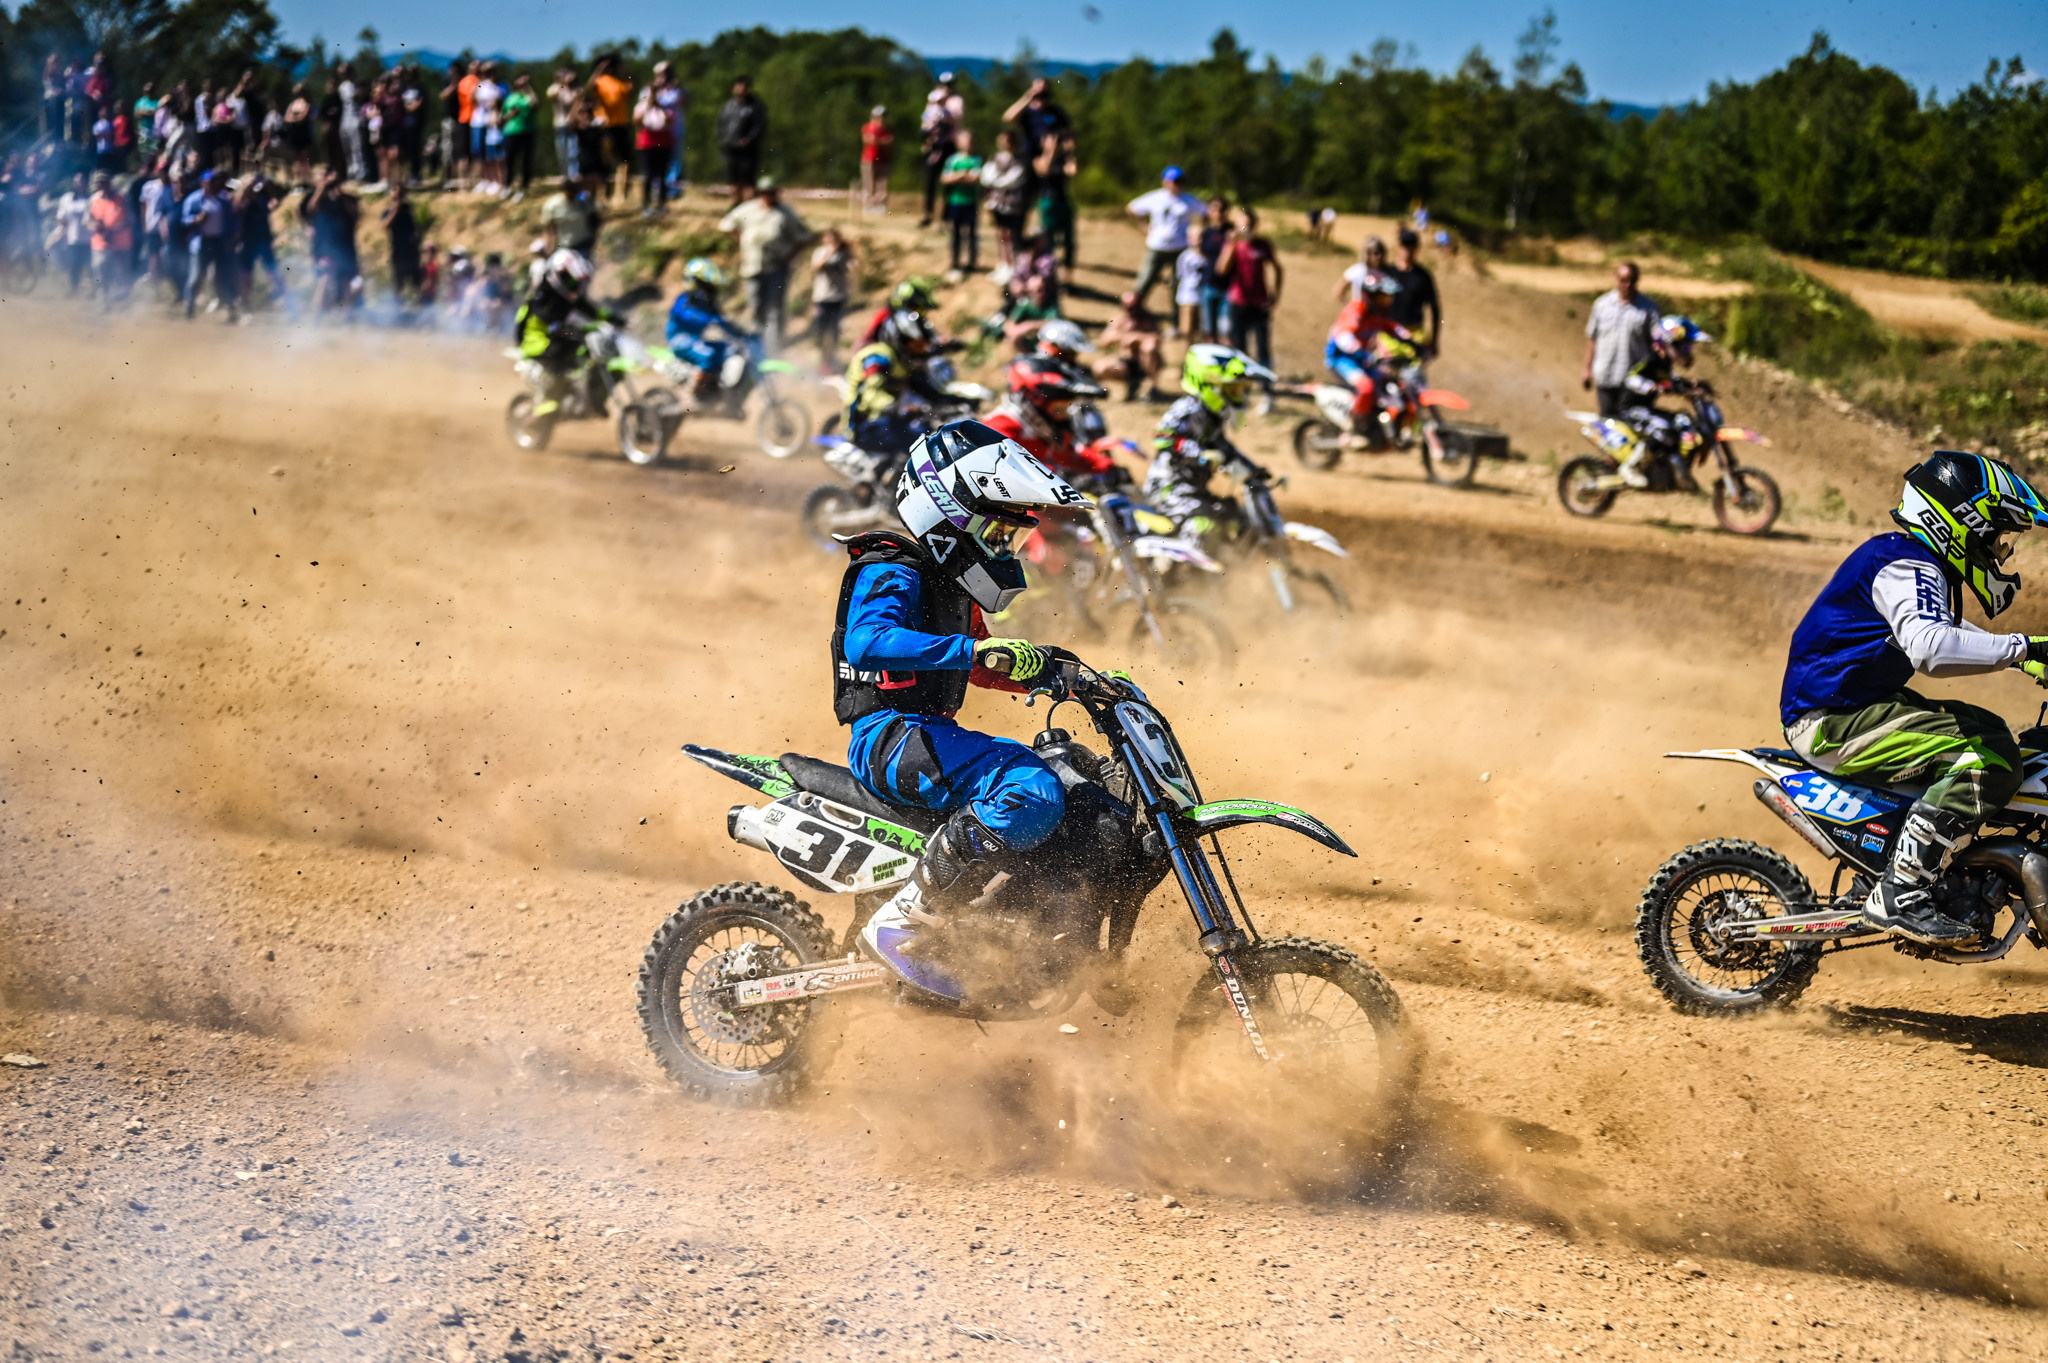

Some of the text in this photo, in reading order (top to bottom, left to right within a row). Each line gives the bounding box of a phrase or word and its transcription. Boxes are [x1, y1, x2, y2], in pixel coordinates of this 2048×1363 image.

[919, 471, 970, 518] LEATT
[993, 477, 1011, 498] LEATT
[1952, 502, 1995, 537] FOX
[1913, 566, 1943, 622] LEATT
[1794, 776, 1872, 820] 36
[780, 820, 875, 883] 31
[872, 856, 908, 874] РОМАНОВ
[1805, 921, 1847, 930] BRAKING
[766, 981, 782, 990] RK
[1225, 977, 1270, 1060] DUNLOP
